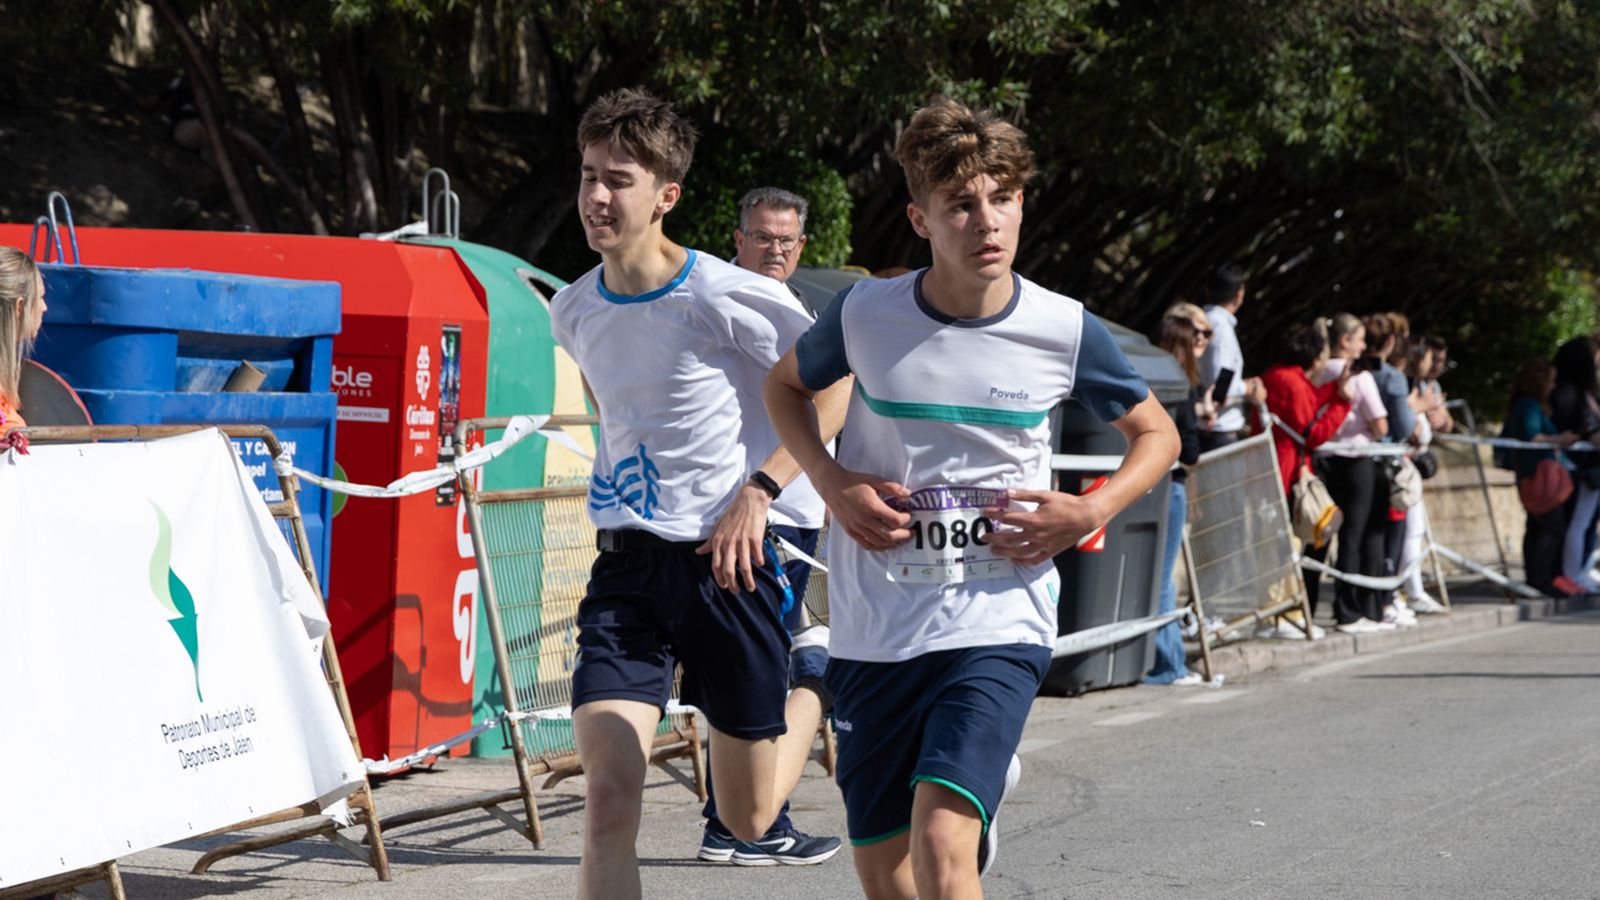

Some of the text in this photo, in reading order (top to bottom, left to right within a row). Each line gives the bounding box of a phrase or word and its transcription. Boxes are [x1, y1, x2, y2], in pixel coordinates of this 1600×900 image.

[990, 387, 1029, 400] Poveda
[406, 404, 435, 426] Cáritas
[244, 441, 253, 456] Y
[967, 497, 997, 507] GLORIA
[911, 516, 993, 551] 1080
[161, 704, 256, 744] Patronato Municipal de
[178, 744, 220, 772] Deportes
[219, 739, 232, 759] de
